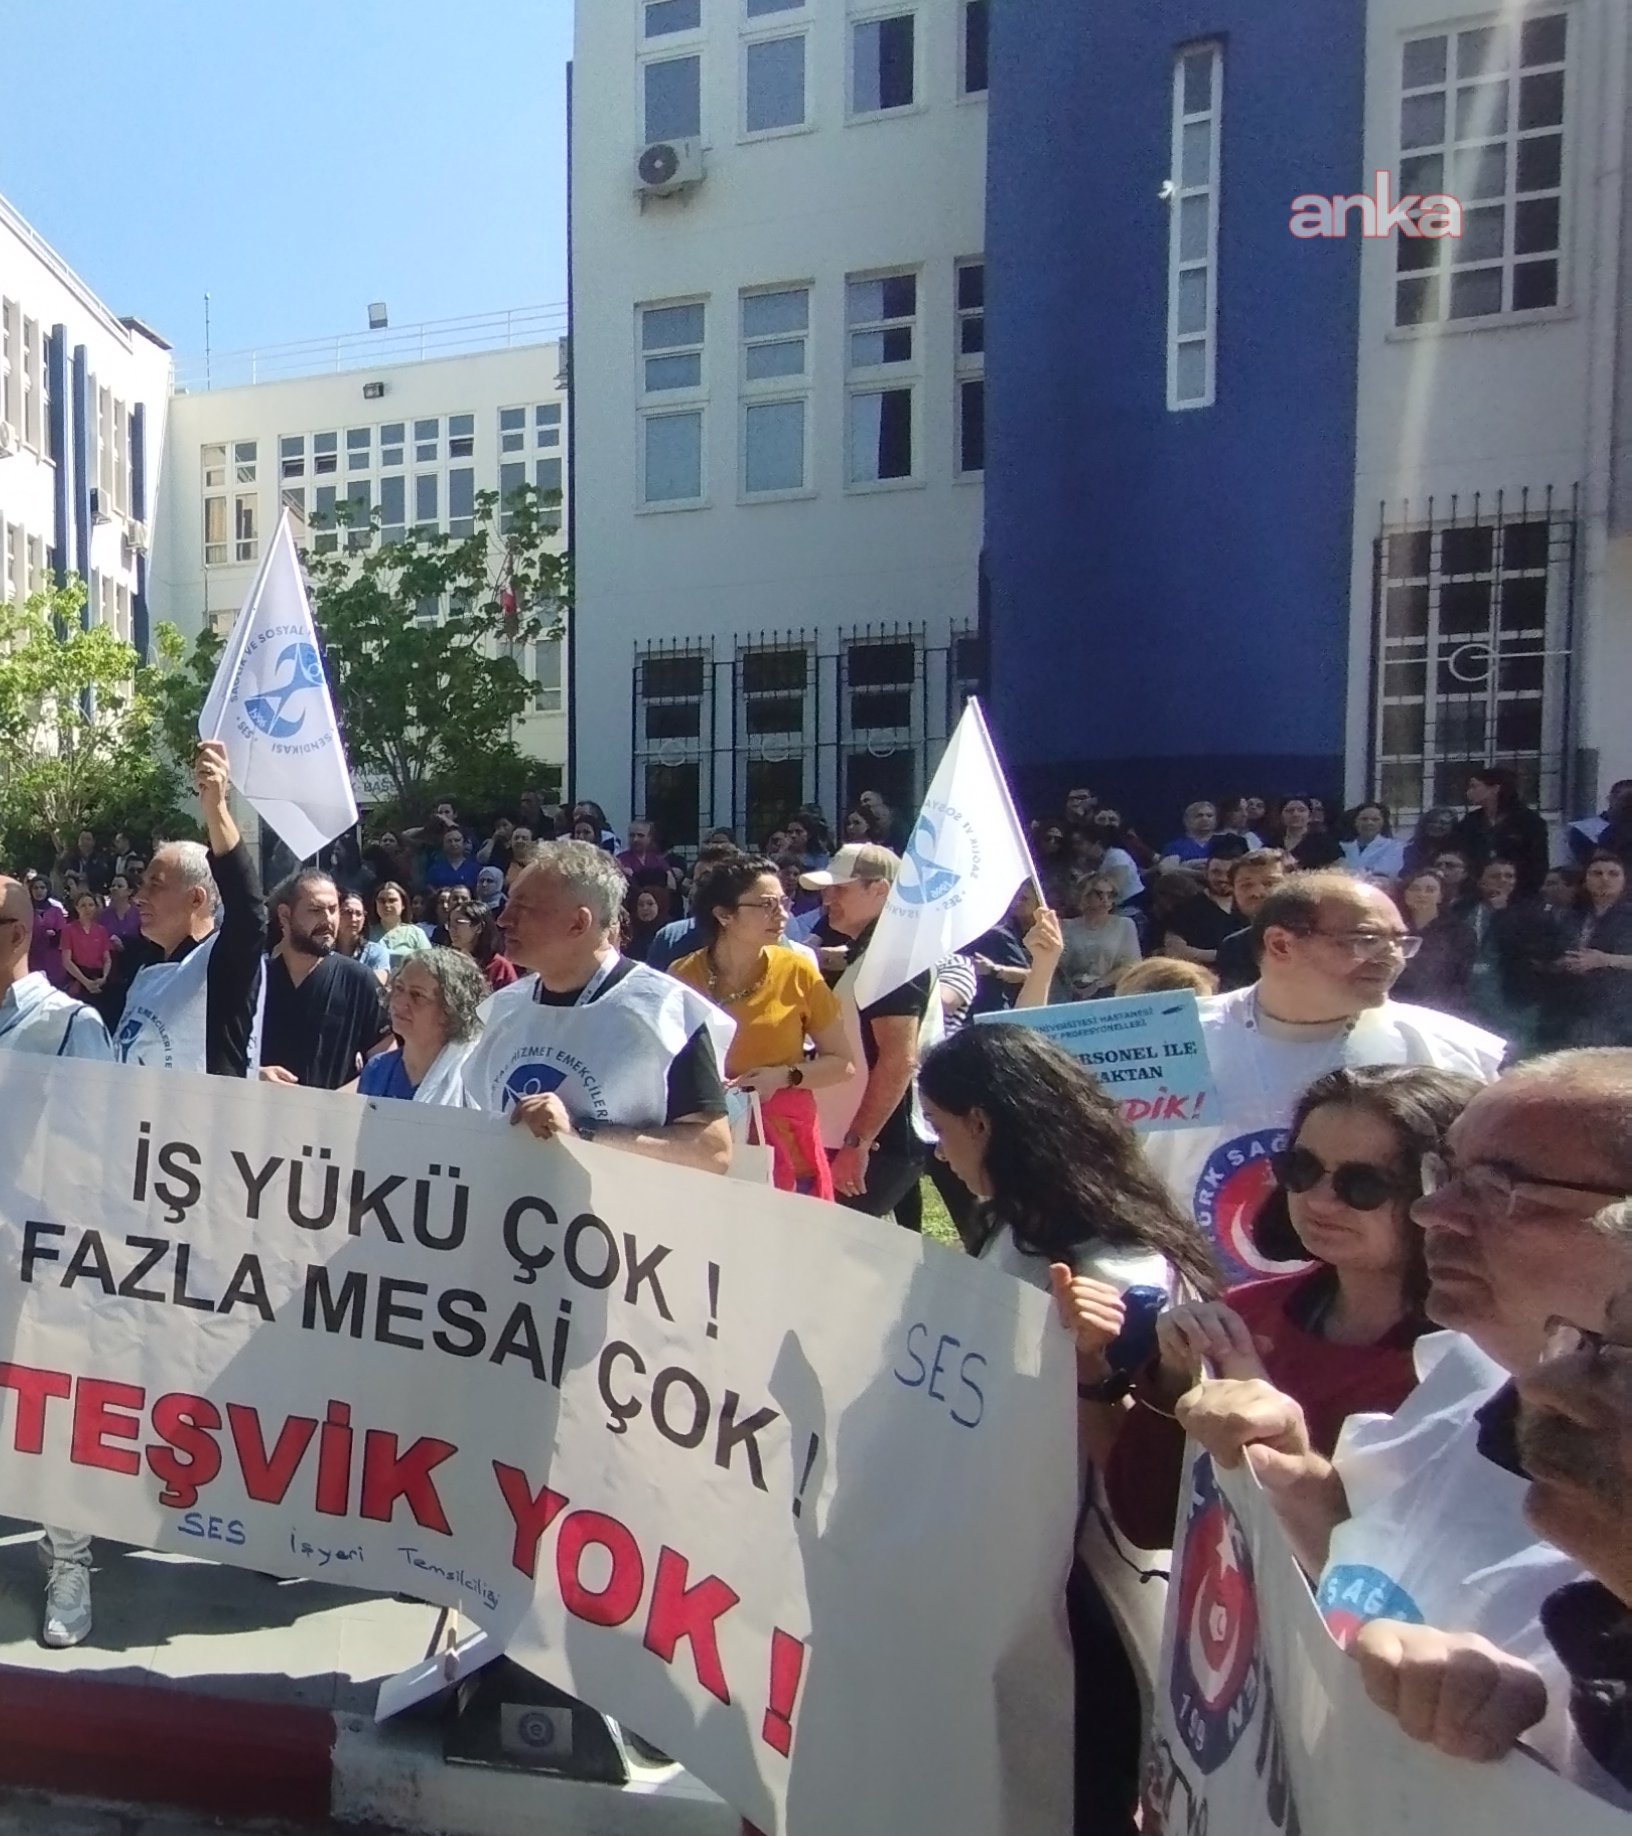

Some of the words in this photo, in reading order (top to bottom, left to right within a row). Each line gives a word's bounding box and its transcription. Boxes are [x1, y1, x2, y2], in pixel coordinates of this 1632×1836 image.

[245, 640, 257, 655] VE
[257, 625, 304, 644] SOSYAL
[1077, 1046, 1158, 1066] RSONEL
[1164, 1040, 1197, 1058] İLE
[1095, 1065, 1164, 1085] AKTAN
[1125, 1086, 1206, 1122] DİK!
[132, 1120, 202, 1224] İŞ
[230, 1145, 470, 1251] YÜKÜ
[502, 1195, 676, 1323] ÇOK
[19, 1220, 276, 1323] FAZLA
[300, 1263, 573, 1389] MESAİ
[597, 1339, 780, 1493] ÇOK
[893, 1322, 988, 1429] SES
[177, 1502, 247, 1546] SES
[491, 1459, 740, 1706] YOK
